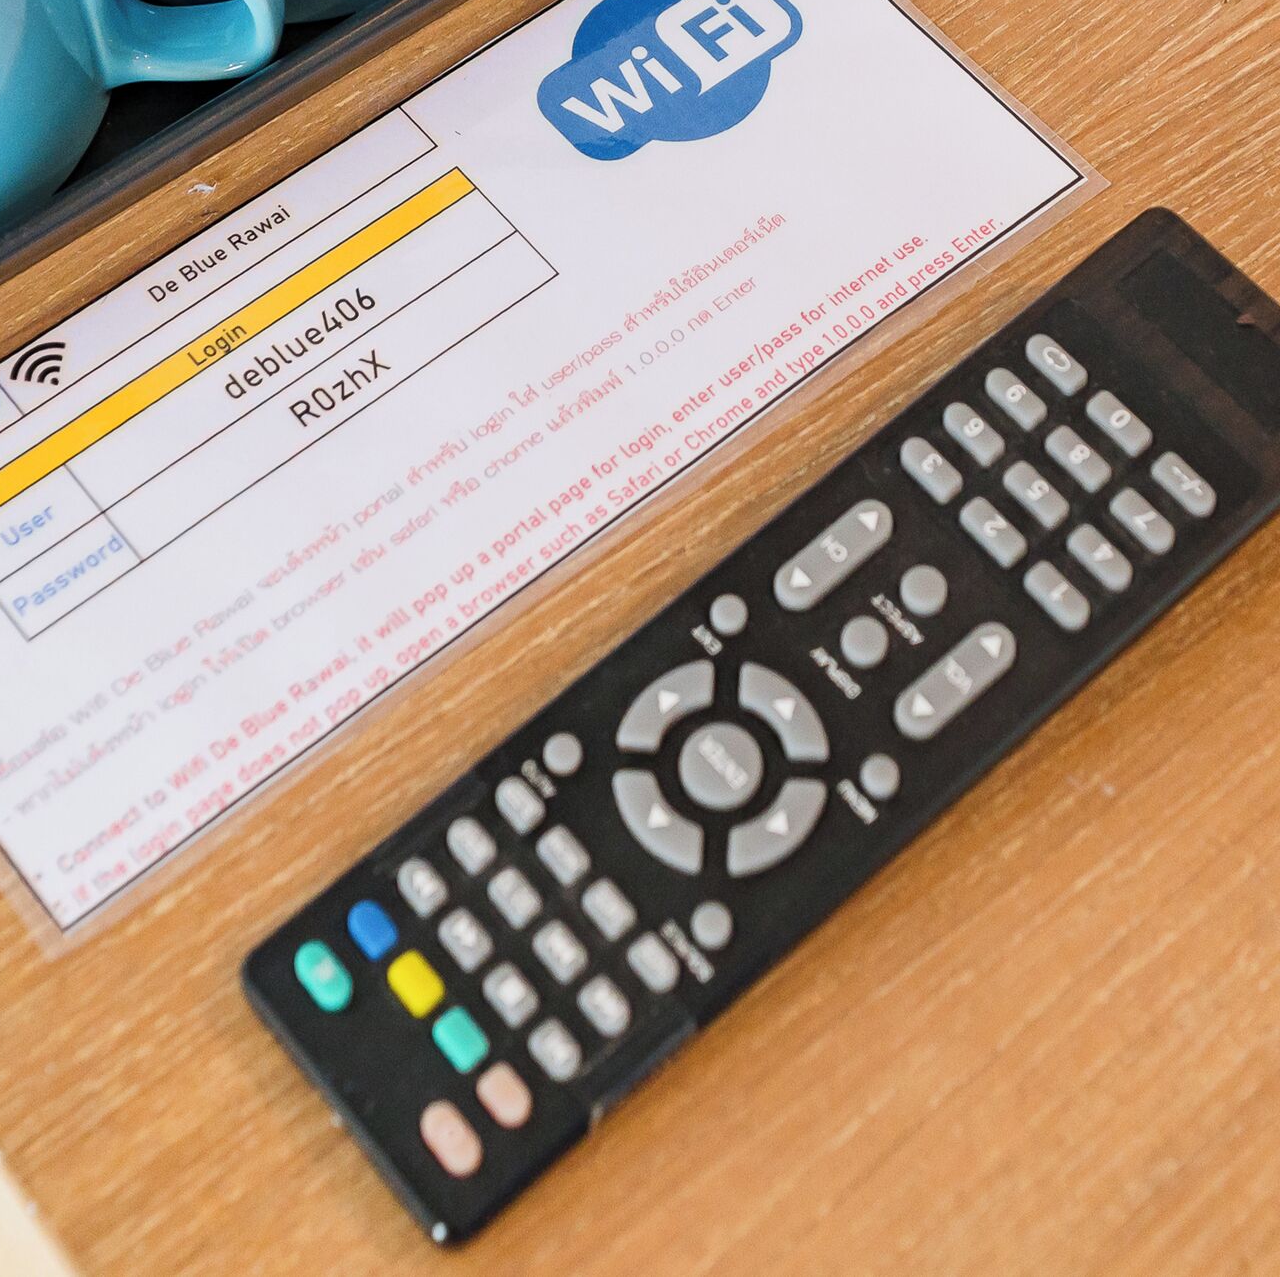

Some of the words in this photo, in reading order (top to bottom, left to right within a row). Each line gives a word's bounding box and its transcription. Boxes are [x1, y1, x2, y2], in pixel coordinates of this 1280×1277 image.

[146, 280, 180, 303] De
[178, 248, 228, 283] Blue
[226, 204, 291, 251] Rawai
[186, 325, 248, 367] Login
[224, 287, 376, 400] deblue406
[270, 570, 347, 632] browser
[389, 504, 440, 547] safari
[624, 328, 686, 376] 1.0.0.0
[711, 276, 757, 312] Enter
[352, 482, 405, 529] portal
[468, 407, 516, 442] login
[540, 330, 623, 391] user/pass
[0, 505, 53, 547] User
[56, 805, 143, 875] Connect
[208, 734, 241, 761] De
[239, 699, 289, 740] Blue
[374, 607, 412, 640] will
[411, 583, 449, 618] pop
[449, 562, 475, 586] up
[491, 507, 548, 559] portal
[547, 476, 593, 517] page
[591, 454, 619, 480] for
[618, 423, 673, 459] login,
[672, 383, 716, 423] enter
[718, 322, 803, 388] user/pass
[800, 302, 827, 326] for
[825, 256, 894, 307] internet
[892, 236, 929, 261] use.
[128, 820, 192, 870] login
[185, 781, 244, 831] page
[237, 743, 288, 784] does
[287, 715, 323, 747] not
[323, 687, 370, 728] pop
[395, 627, 444, 674] open
[457, 556, 535, 619] browser
[538, 523, 584, 561] such
[584, 504, 609, 526] as
[607, 461, 663, 507] Safari
[663, 447, 683, 468] or
[683, 397, 754, 451] Chrome
[754, 368, 789, 400] and
[785, 344, 832, 375] type
[821, 305, 876, 347] 1.0.0.0
[876, 281, 909, 311] and
[906, 250, 955, 292] press
[950, 218, 1004, 254] Enter.
[821, 533, 849, 563] CH
[11, 533, 125, 617] Password
[872, 591, 923, 647] ASPECT
[811, 643, 861, 699] DISPLAY
[941, 658, 974, 693] VOL
[836, 778, 878, 823] MENU
